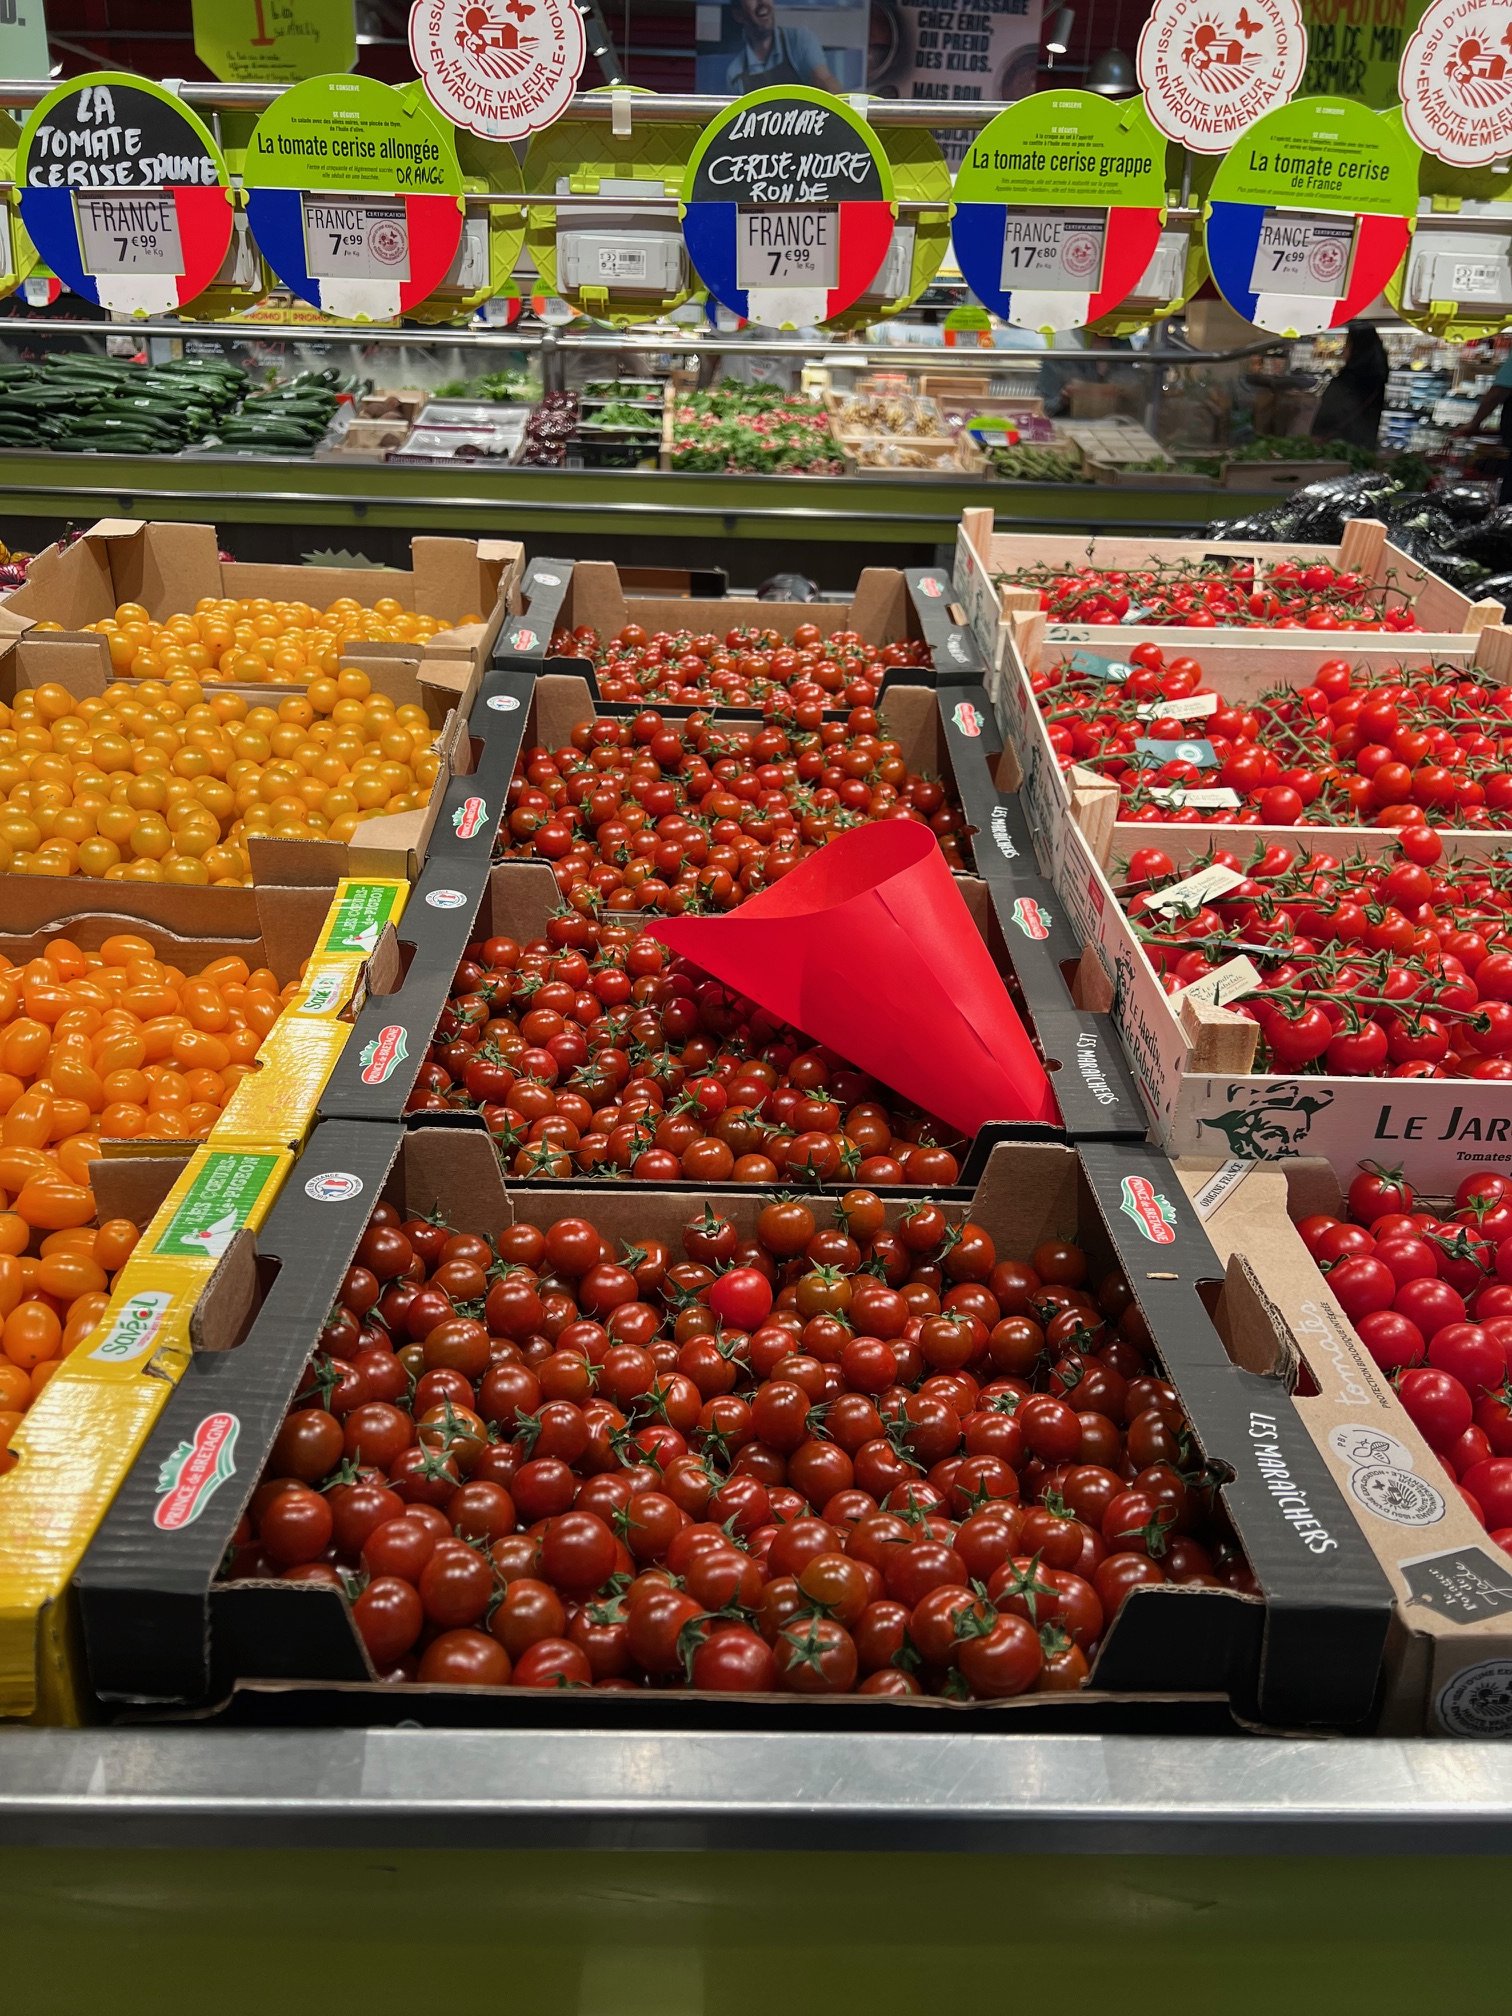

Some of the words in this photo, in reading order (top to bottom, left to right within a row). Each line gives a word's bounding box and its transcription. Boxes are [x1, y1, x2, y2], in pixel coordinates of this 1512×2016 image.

[918, 10, 953, 30] CHEZ
[1157, 16, 1178, 53] ISSU
[943, 32, 989, 53] PREND
[1421, 28, 1444, 66] ISSU
[430, 48, 566, 120] ENVIRONNEMENTALE
[449, 60, 493, 103] HAUTE
[497, 62, 548, 103] VALEUR
[1155, 64, 1286, 133] ENVIRONNEMENTALE
[1172, 75, 1211, 116] HAUTE
[1214, 77, 1267, 117] VALEUR
[77, 86, 115, 124] LA
[1417, 77, 1512, 146] ENVIRONNEMEN
[1432, 88, 1468, 130] HAUTE
[1471, 110, 1512, 132] VALEU
[36, 125, 142, 160] TOMATE
[257, 132, 274, 154] La
[278, 135, 328, 156] tomate
[332, 136, 376, 158] cerise
[380, 138, 440, 164] allongée
[29, 160, 134, 187] CERISE
[972, 148, 989, 169] La
[994, 149, 1046, 171] tomate
[1050, 151, 1096, 173] cerise
[1099, 156, 1152, 178] grappe
[1249, 150, 1268, 172] La
[1274, 153, 1333, 176] tomate
[1338, 160, 1390, 181] cerise
[1291, 175, 1303, 188] de
[1306, 176, 1343, 191] France
[90, 201, 172, 232] FRANCE
[306, 209, 365, 230] FRANCE
[749, 215, 827, 246] FRANCE
[1005, 222, 1062, 243] FRANCE
[1260, 226, 1312, 247] FRANCE
[1077, 1032, 1098, 1049] LES
[1077, 1049, 1119, 1105] MARAÎCHERS
[1438, 1106, 1512, 1142] JAR
[1456, 1151, 1512, 1162] Tomates
[1199, 1182, 1226, 1208] ORIGINE
[1220, 1162, 1244, 1186] FRANCE
[184, 1202, 212, 1225] LES
[1131, 1179, 1150, 1201] PRINCE
[1143, 1205, 1169, 1241] BRETAGNE
[101, 1298, 159, 1355] Savéol
[1294, 1300, 1371, 1405] tomates
[1336, 1327, 1366, 1368] BIOLOGIQUE
[1360, 1364, 1391, 1409] PROTECTION
[1248, 1412, 1279, 1440] LES
[1337, 1433, 1348, 1448] PBI
[163, 1484, 197, 1526] PRINCE
[189, 1418, 229, 1473] BRETAGNE
[1253, 1443, 1338, 1554] MARAÎCHERS
[1428, 1568, 1478, 1611] Potager
[1455, 1561, 1512, 1606] Jade
